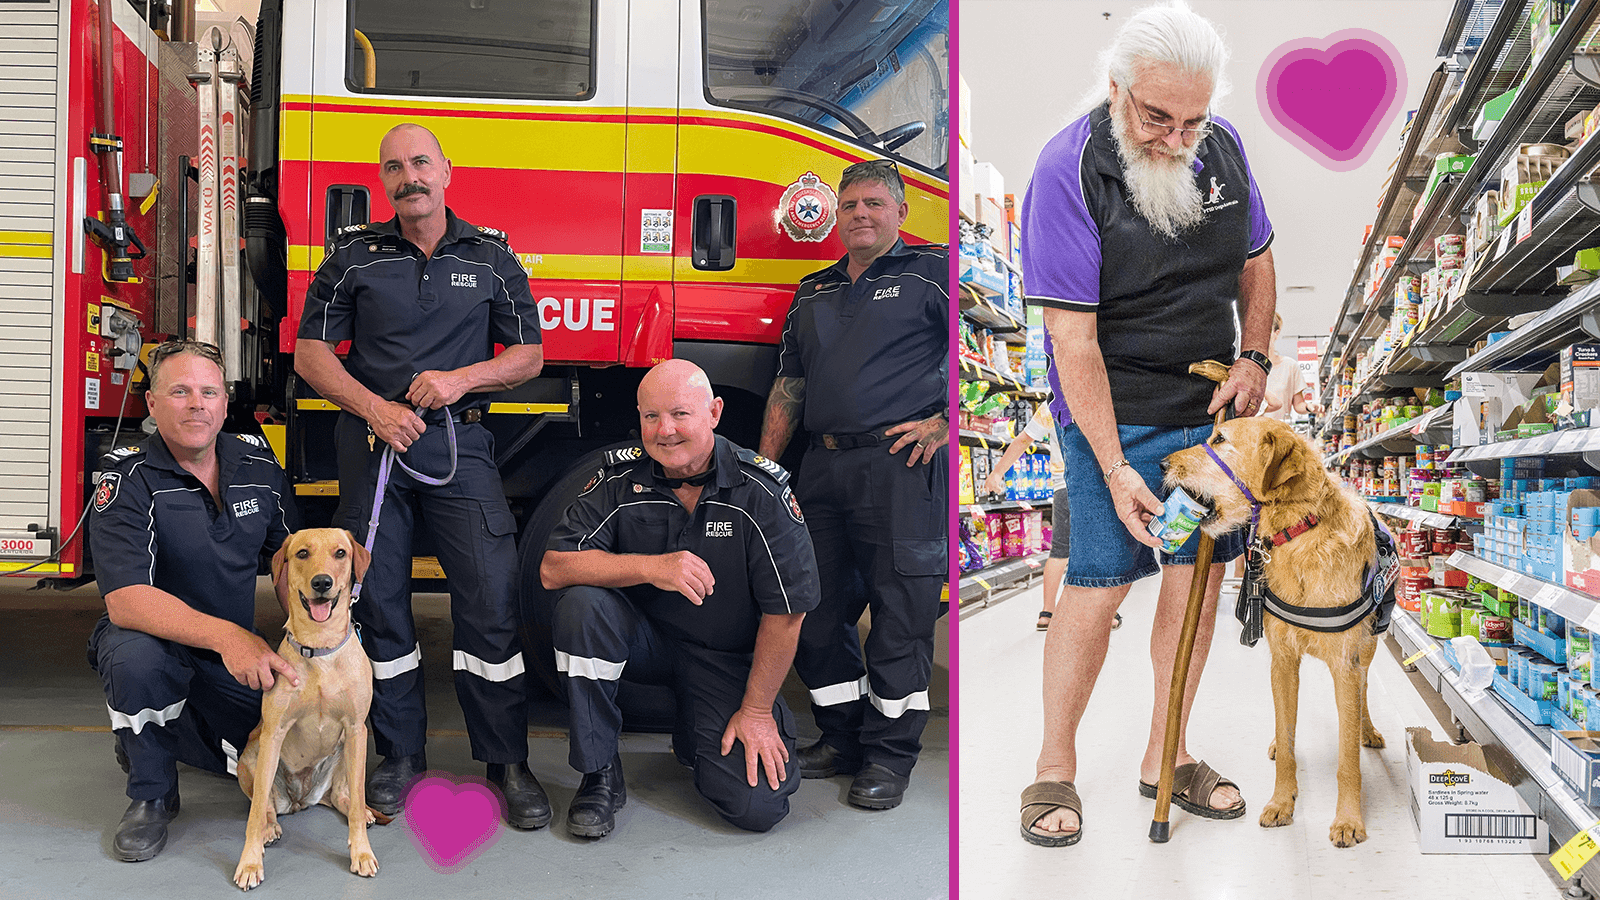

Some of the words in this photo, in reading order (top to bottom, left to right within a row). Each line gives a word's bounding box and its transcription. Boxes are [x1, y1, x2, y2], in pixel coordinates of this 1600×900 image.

[203, 187, 213, 236] WAKÜ
[525, 254, 543, 264] AIR
[450, 273, 477, 283] FIRE
[872, 292, 900, 301] RESCUE
[874, 285, 901, 297] FIRE
[537, 297, 615, 331] CUE
[232, 498, 259, 513] FIRE
[235, 506, 260, 518] RESCUE
[706, 521, 733, 531] FIRE
[1, 539, 34, 550] 3000
[1431, 774, 1449, 782] DEEP
